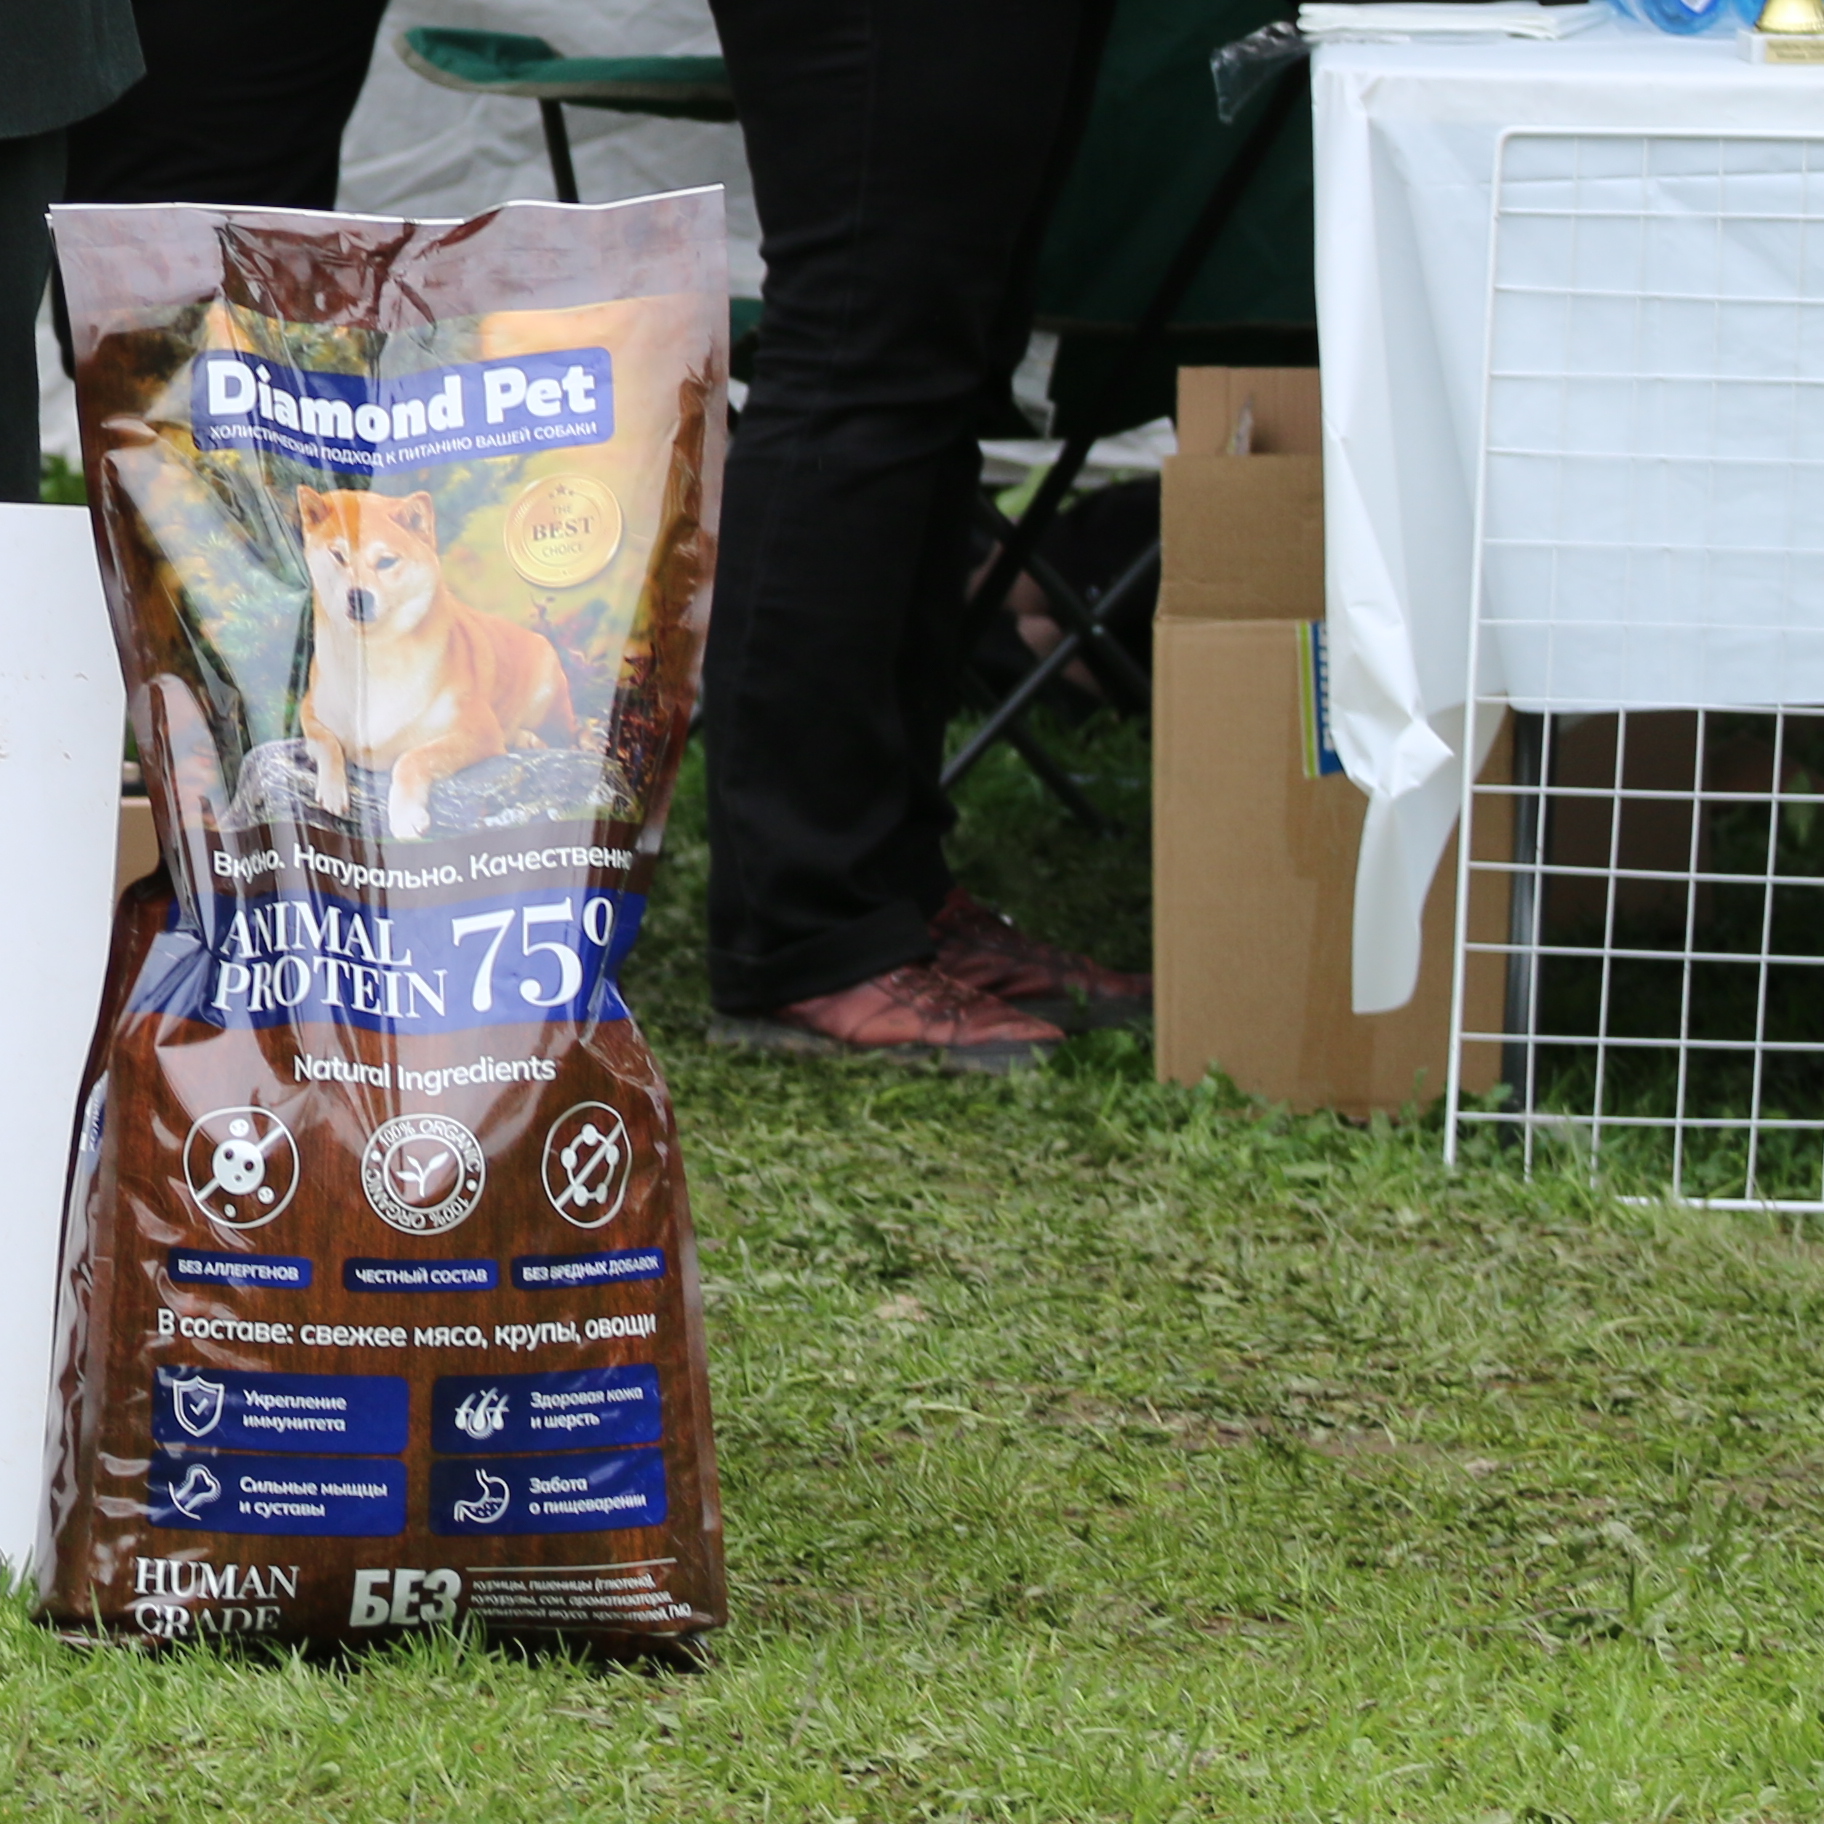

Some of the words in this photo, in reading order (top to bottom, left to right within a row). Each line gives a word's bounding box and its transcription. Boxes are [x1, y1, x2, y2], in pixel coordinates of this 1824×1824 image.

[206, 358, 465, 445] Diamond
[483, 364, 597, 425] Pet
[320, 445, 385, 468] ПОДХОД
[386, 450, 396, 465] К
[398, 435, 473, 463] ПИТАНИЮ
[475, 427, 531, 451] ВАШЕЙ
[534, 420, 598, 442] СОБАКИ
[532, 516, 595, 542] BEST
[541, 543, 582, 558] CHOICE
[293, 842, 464, 890] Натурально.
[218, 899, 413, 968] ANIMAL
[210, 955, 449, 1019] PROTEIN
[293, 1053, 392, 1090] Natural
[396, 1055, 558, 1097] Ingredients
[377, 1120, 416, 1148] 100%
[418, 1119, 482, 1174] ORGANIC
[364, 1168, 427, 1230] ORGANIC
[177, 1258, 203, 1274] БЕЗ
[204, 1262, 300, 1282] АЛЛЕРГЕНОВ
[355, 1266, 429, 1285] ЧЕСТНЫЙ
[430, 1268, 488, 1285] СОСТАВ
[522, 1265, 549, 1282] БЕЗ
[157, 1307, 176, 1338] В
[179, 1316, 295, 1345] составе:
[300, 1323, 408, 1348] свежее
[413, 1325, 489, 1350] мясо,
[494, 1320, 582, 1353] крупы,
[584, 1313, 657, 1340] овощи
[242, 1389, 348, 1412] Укрепление
[529, 1388, 605, 1410] Здоровая
[606, 1386, 644, 1403] кожа
[242, 1414, 347, 1434] иммунитета
[530, 1415, 542, 1430] и
[544, 1412, 601, 1432] шерсть
[238, 1475, 319, 1497] Сильные
[528, 1476, 589, 1495] Забота
[238, 1500, 252, 1515] и
[253, 1501, 326, 1520] суставы
[528, 1501, 541, 1515] о
[543, 1493, 647, 1516] пищеварении
[134, 1556, 301, 1601] HUMAN
[349, 1568, 462, 1628] БЕЗ
[134, 1603, 282, 1639] GRADE
